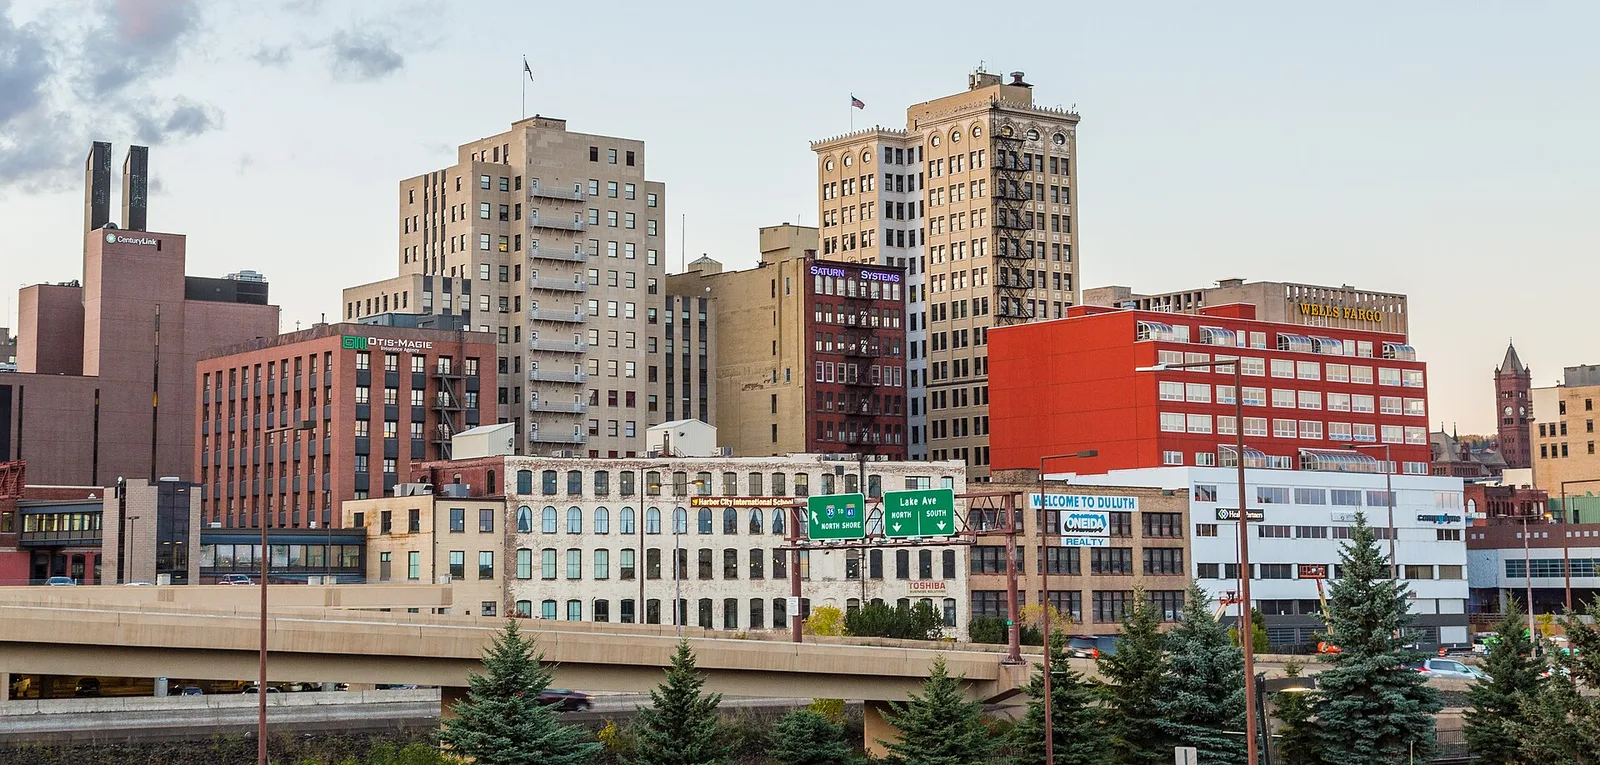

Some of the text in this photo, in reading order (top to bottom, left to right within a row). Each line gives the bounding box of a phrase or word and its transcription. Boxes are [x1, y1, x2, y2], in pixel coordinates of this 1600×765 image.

[117, 235, 157, 246] CenturyLink
[810, 266, 900, 282] SATURN SYSTEMS
[1300, 303, 1383, 322] WELLS FARGO
[368, 337, 433, 349] OTIS-MAGIE
[720, 498, 732, 506] City
[900, 496, 936, 506] Lake Ave
[1033, 494, 1134, 509] WELCOME TO DULUTH
[1064, 514, 1107, 532] ONEIDA
